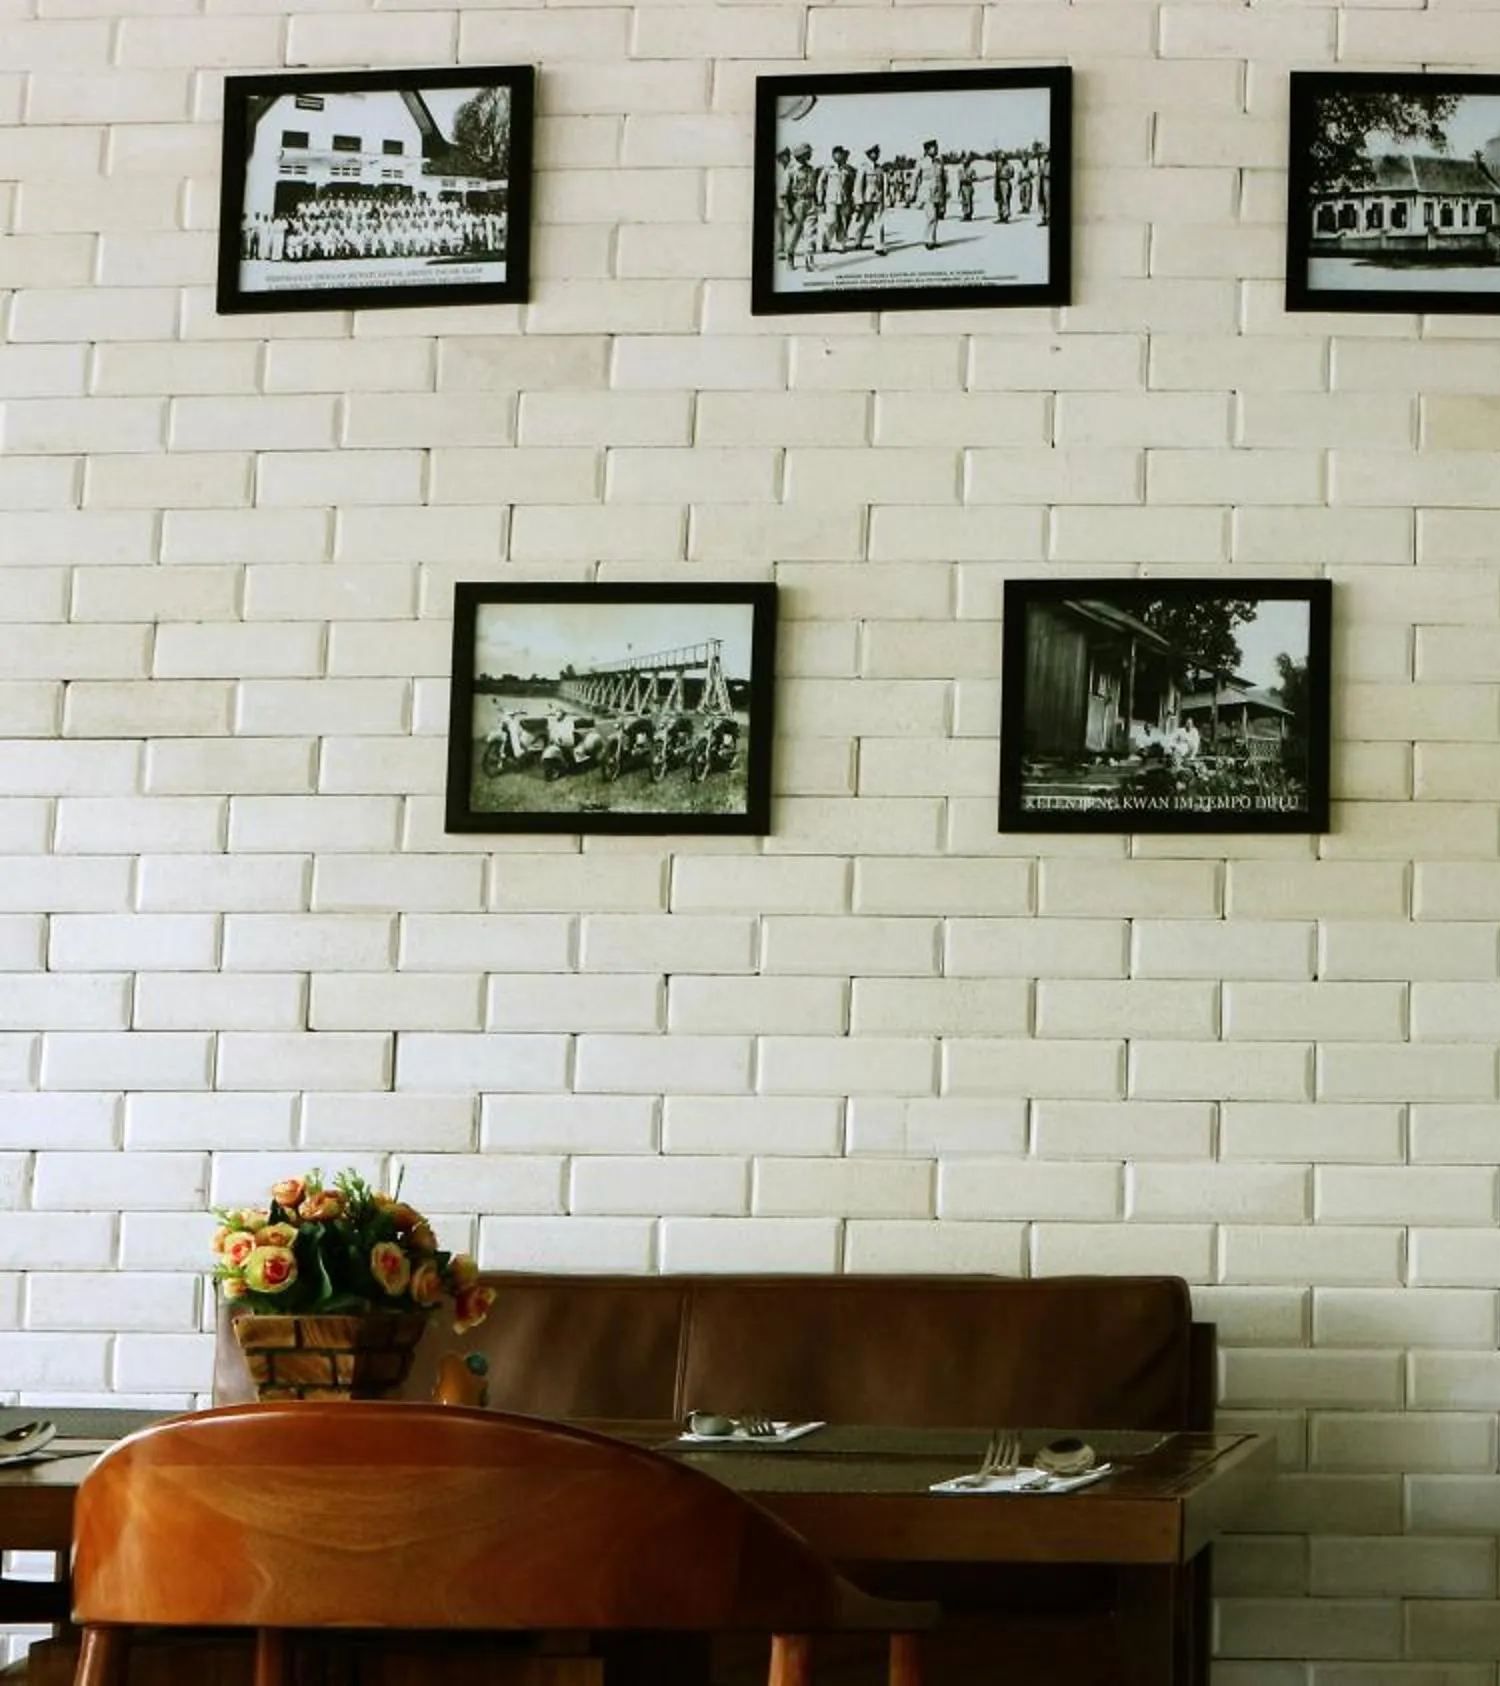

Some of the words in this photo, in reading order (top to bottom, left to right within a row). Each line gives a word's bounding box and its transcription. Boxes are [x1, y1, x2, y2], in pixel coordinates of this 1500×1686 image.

[1123, 796, 1169, 809] KWAN
[1174, 796, 1193, 809] IM
[1197, 796, 1251, 809] TEMPO
[1255, 796, 1299, 810] DULU
